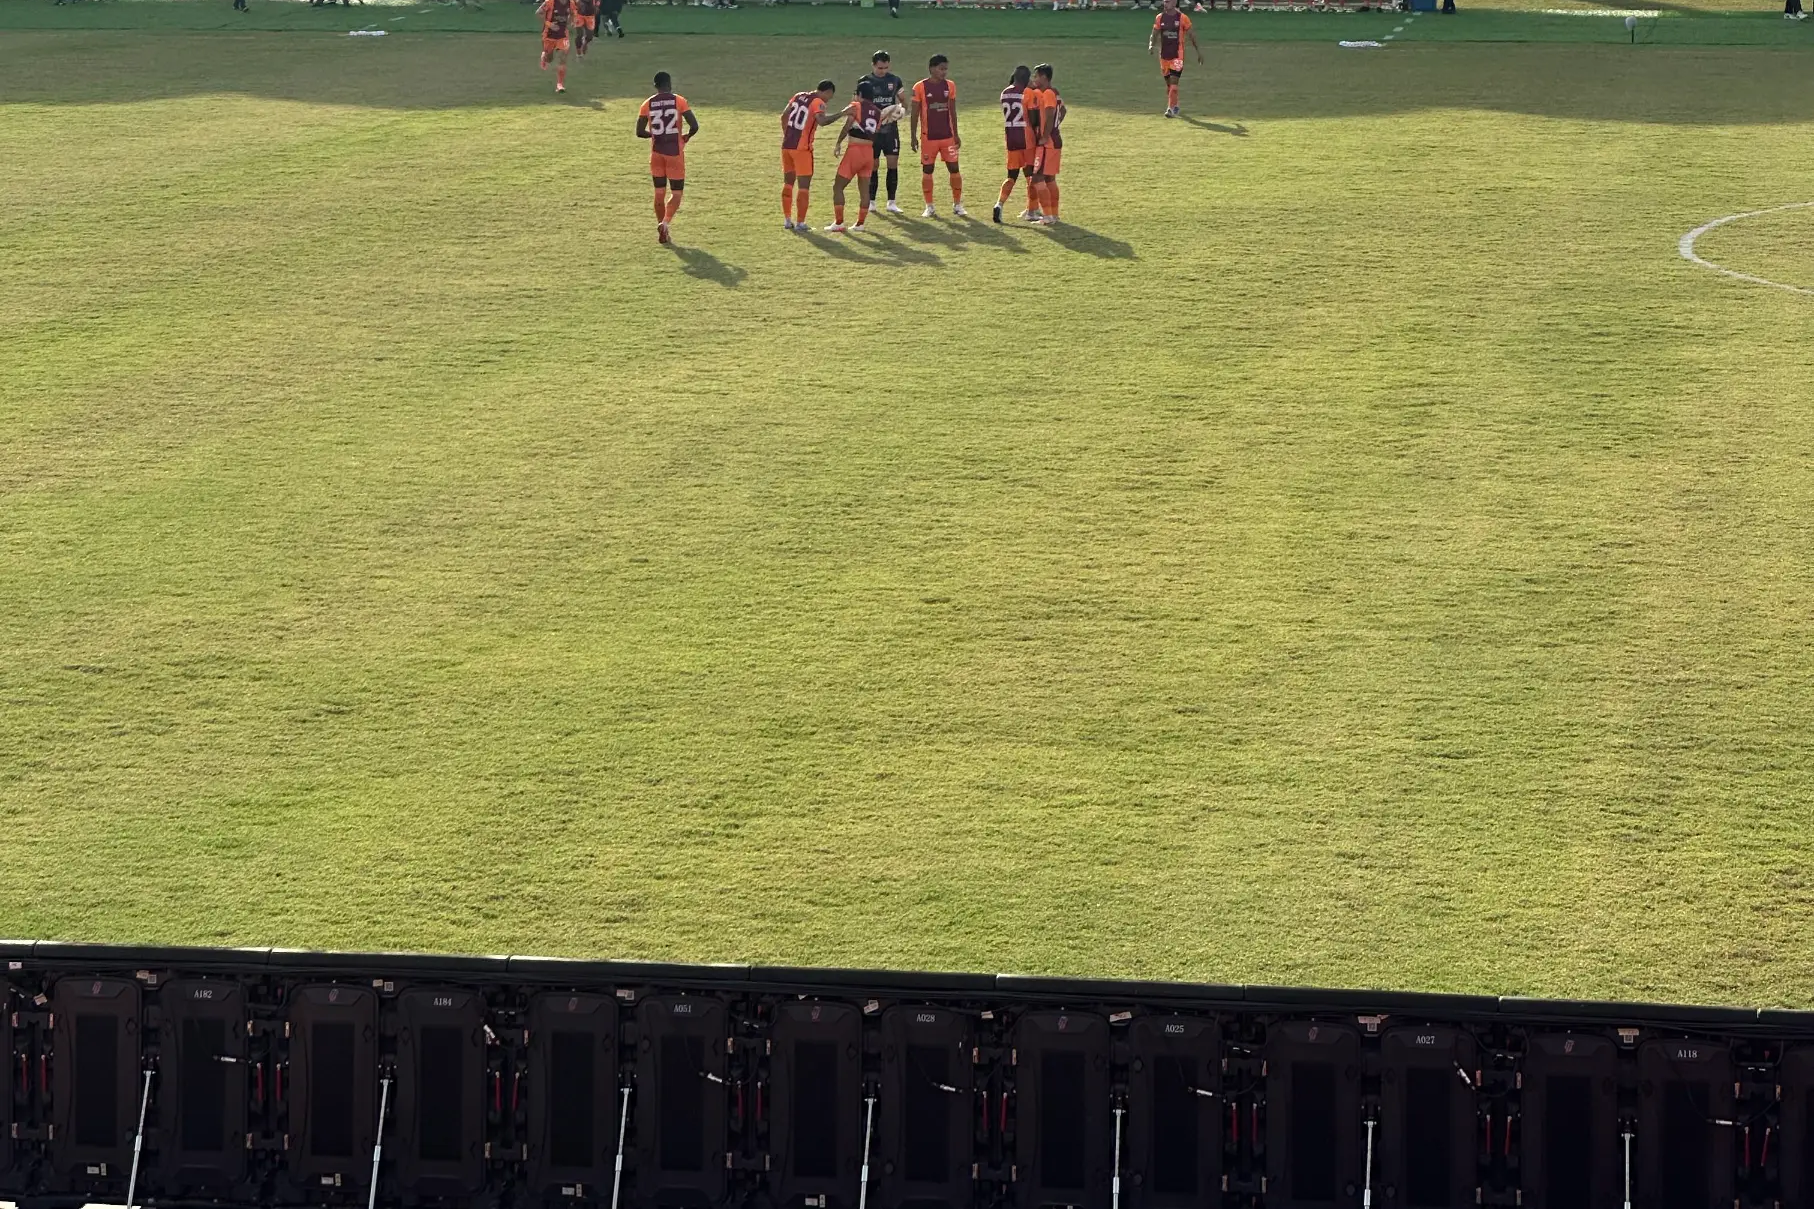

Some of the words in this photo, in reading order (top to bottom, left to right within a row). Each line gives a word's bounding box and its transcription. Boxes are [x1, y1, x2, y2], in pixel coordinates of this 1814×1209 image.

[787, 102, 809, 131] 20
[1002, 101, 1028, 128] 22
[649, 108, 679, 136] 32
[193, 989, 213, 999] A182
[433, 997, 452, 1007] A184
[673, 1004, 692, 1013] A051
[916, 1013, 935, 1023] A028
[1165, 1024, 1184, 1033] A025
[1415, 1035, 1436, 1044] A027
[1677, 1048, 1698, 1058] A118
